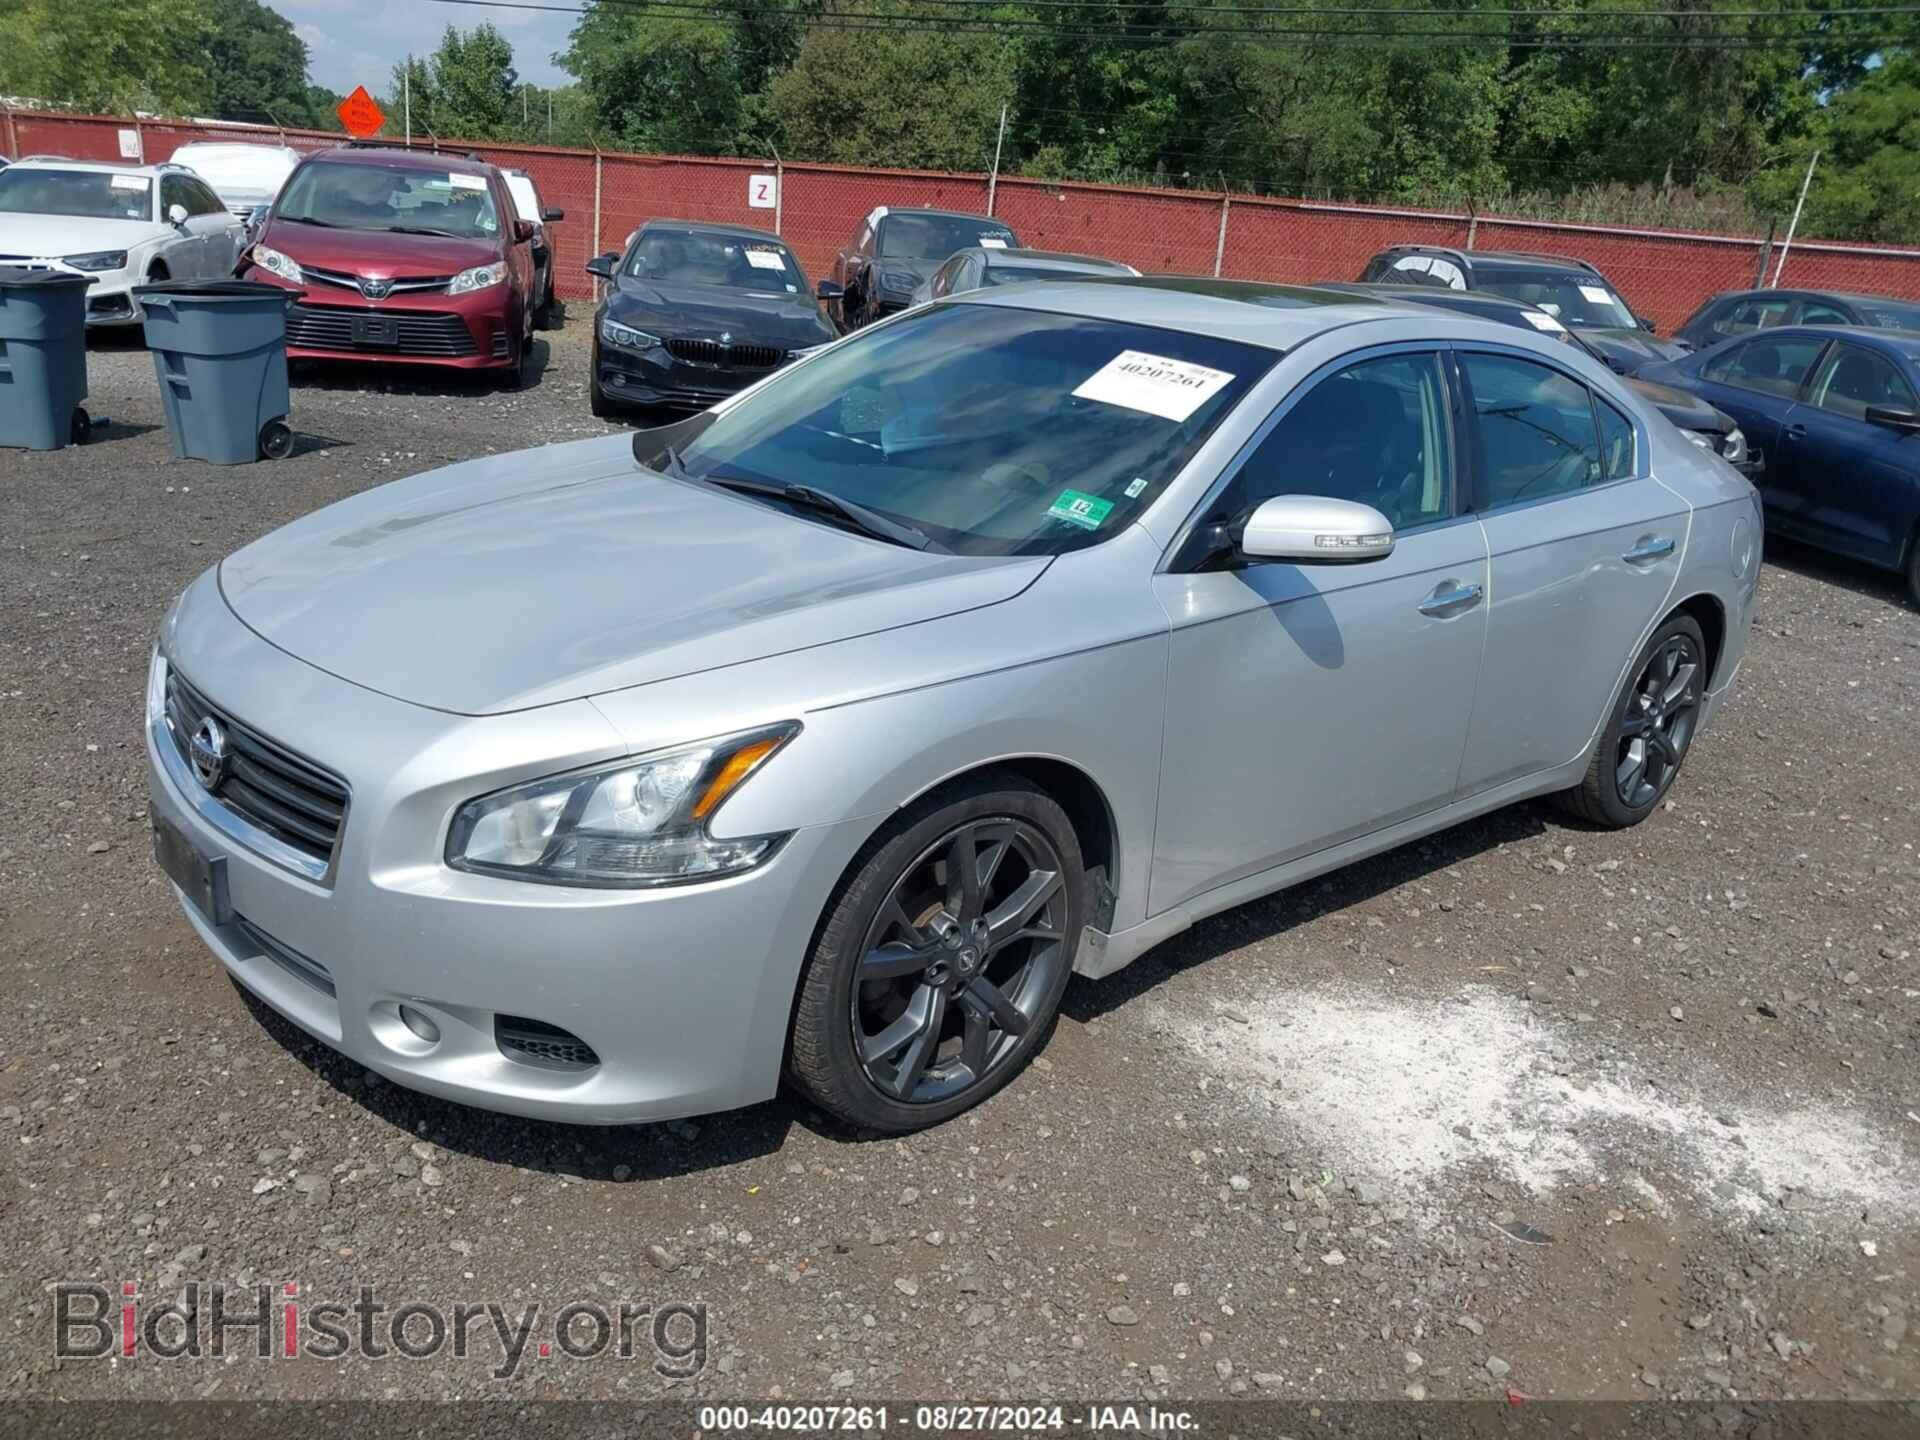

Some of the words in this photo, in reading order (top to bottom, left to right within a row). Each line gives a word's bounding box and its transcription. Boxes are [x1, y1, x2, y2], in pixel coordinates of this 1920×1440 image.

[757, 183, 767, 200] Z
[1118, 362, 1206, 389] 40207261
[1074, 501, 1091, 513] 12
